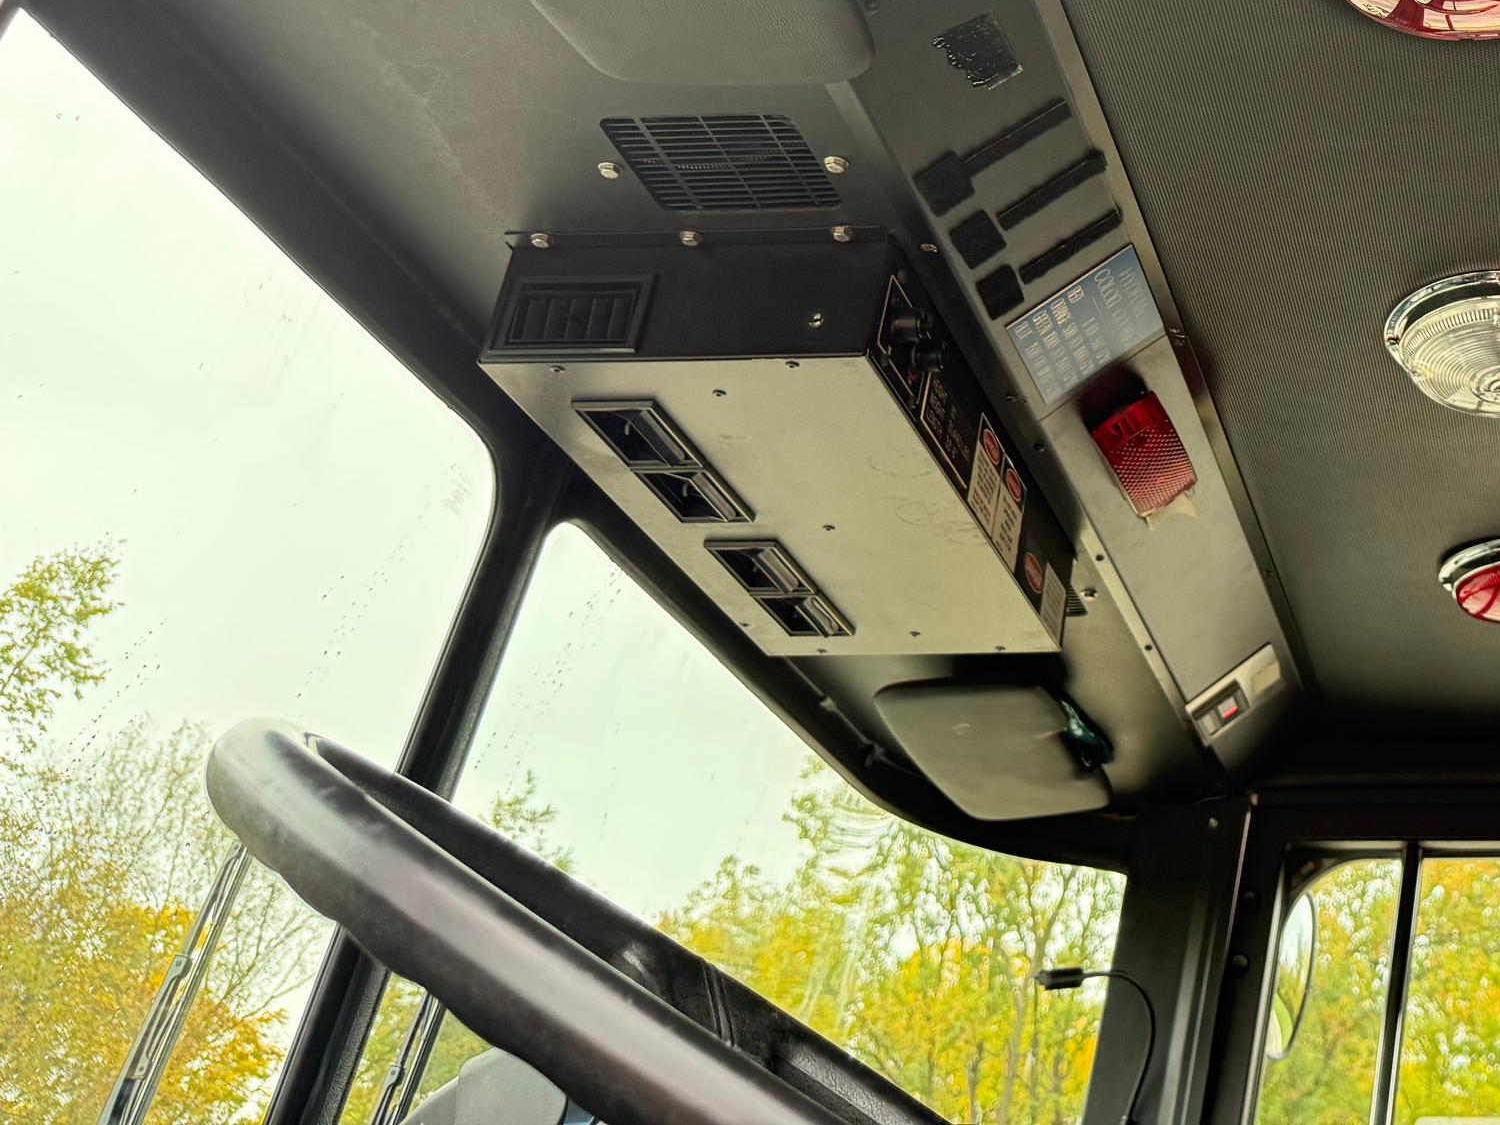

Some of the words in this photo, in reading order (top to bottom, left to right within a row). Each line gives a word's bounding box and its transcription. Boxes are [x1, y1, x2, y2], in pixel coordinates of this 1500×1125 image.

[1066, 284, 1085, 304] RED
[1093, 266, 1122, 309] COLOR
[1031, 308, 1054, 335] GREEN
[1049, 295, 1072, 325] ORANGE
[1013, 320, 1033, 340] BLUE
